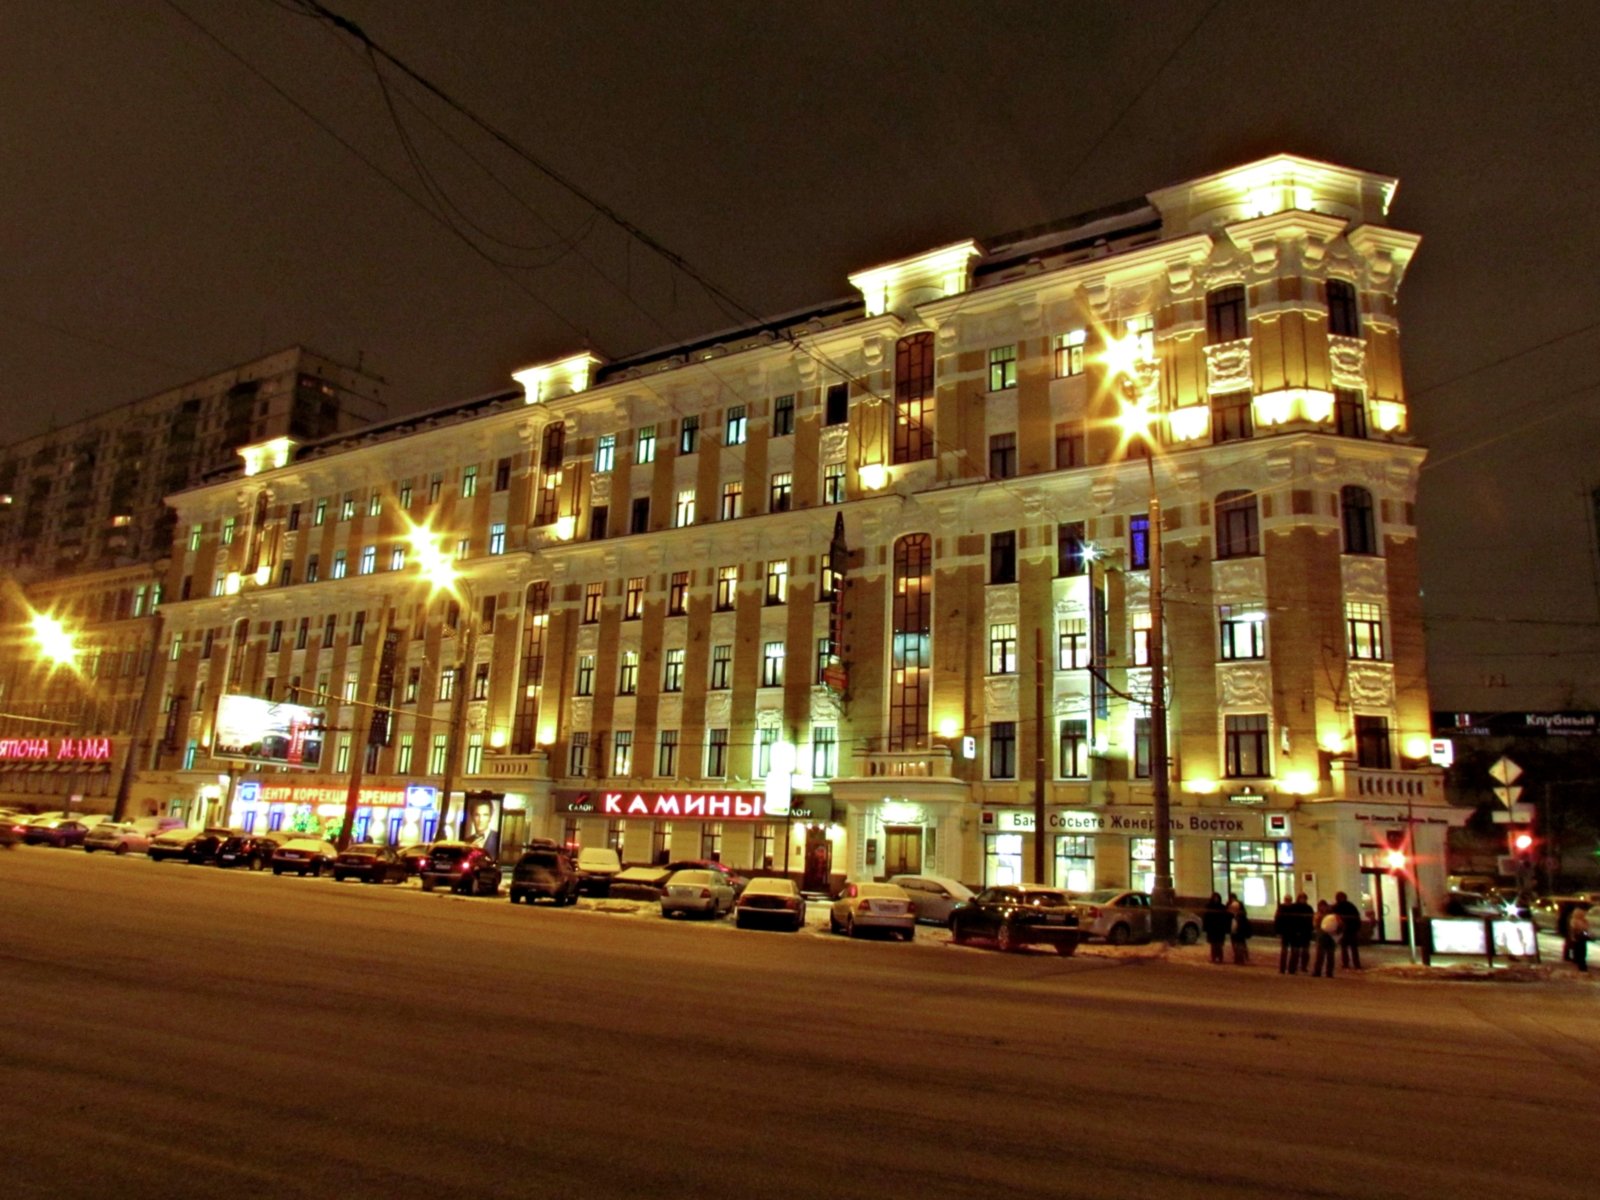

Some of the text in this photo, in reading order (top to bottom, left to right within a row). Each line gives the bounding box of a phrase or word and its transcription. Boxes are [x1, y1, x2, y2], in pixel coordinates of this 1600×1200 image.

[292, 788, 348, 804] КОРРЕКЦИ
[358, 789, 405, 805] ЗРЕНИЯ
[605, 793, 761, 816] КАМИНЫ
[568, 803, 594, 812] САЛОН
[1013, 813, 1244, 832] Бан Сосьете Женерль Восток
